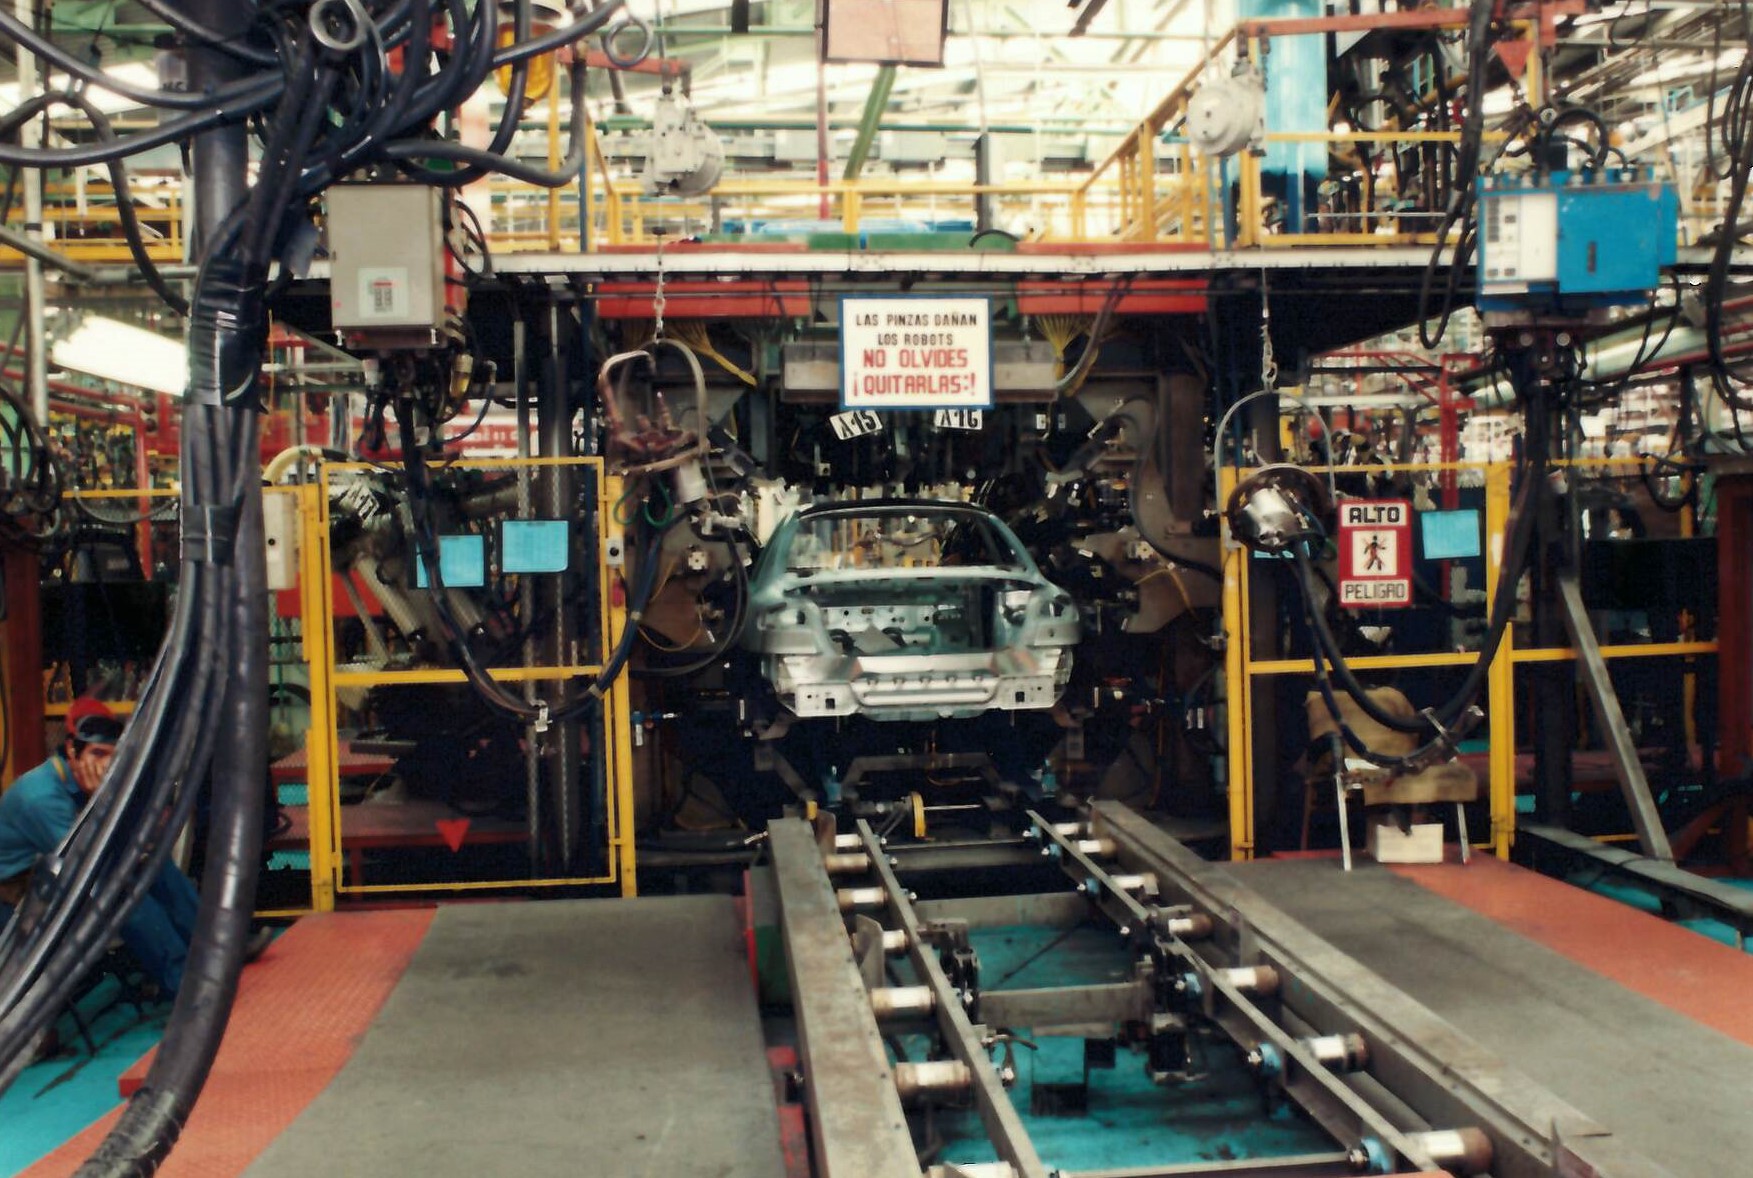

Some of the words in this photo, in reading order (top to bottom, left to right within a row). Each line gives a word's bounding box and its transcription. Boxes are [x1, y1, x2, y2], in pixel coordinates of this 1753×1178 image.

[856, 314, 879, 326] LAS
[887, 314, 929, 326] PINZAS
[935, 311, 977, 326] DAÑAN
[878, 333, 899, 346] LOS
[904, 333, 954, 346] ROBOTS
[863, 349, 886, 368] NO
[899, 349, 968, 368] OLVIDES
[1349, 507, 1400, 523] ALTO
[1345, 583, 1405, 599] PELIGRO
